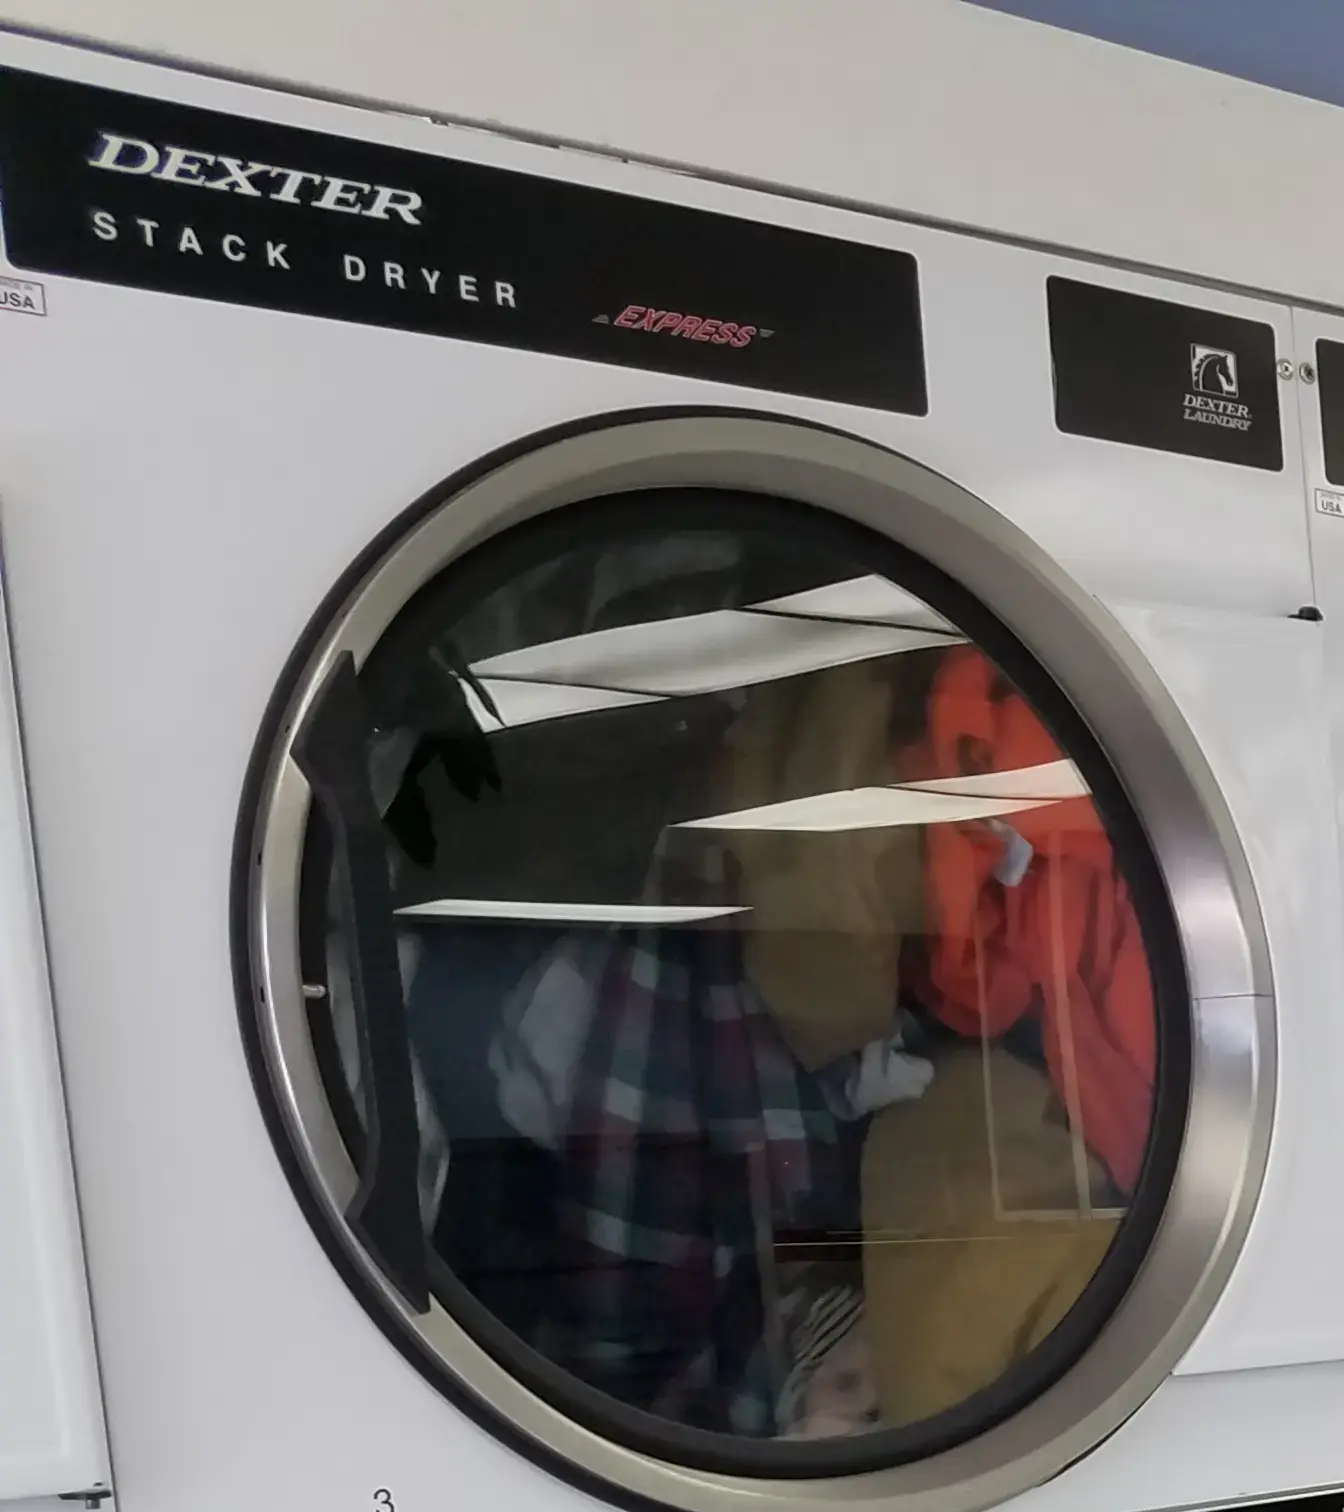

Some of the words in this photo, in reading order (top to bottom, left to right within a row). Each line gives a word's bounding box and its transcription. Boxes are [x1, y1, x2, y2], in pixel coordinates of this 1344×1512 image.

[88, 131, 425, 226] DEXTER
[93, 211, 290, 270] STACK
[344, 254, 517, 308] DRYER
[613, 304, 757, 347] EXPRESS
[1183, 393, 1250, 419] DEXTER
[1183, 408, 1252, 431] LAUNDRY
[1321, 501, 1342, 513] USA
